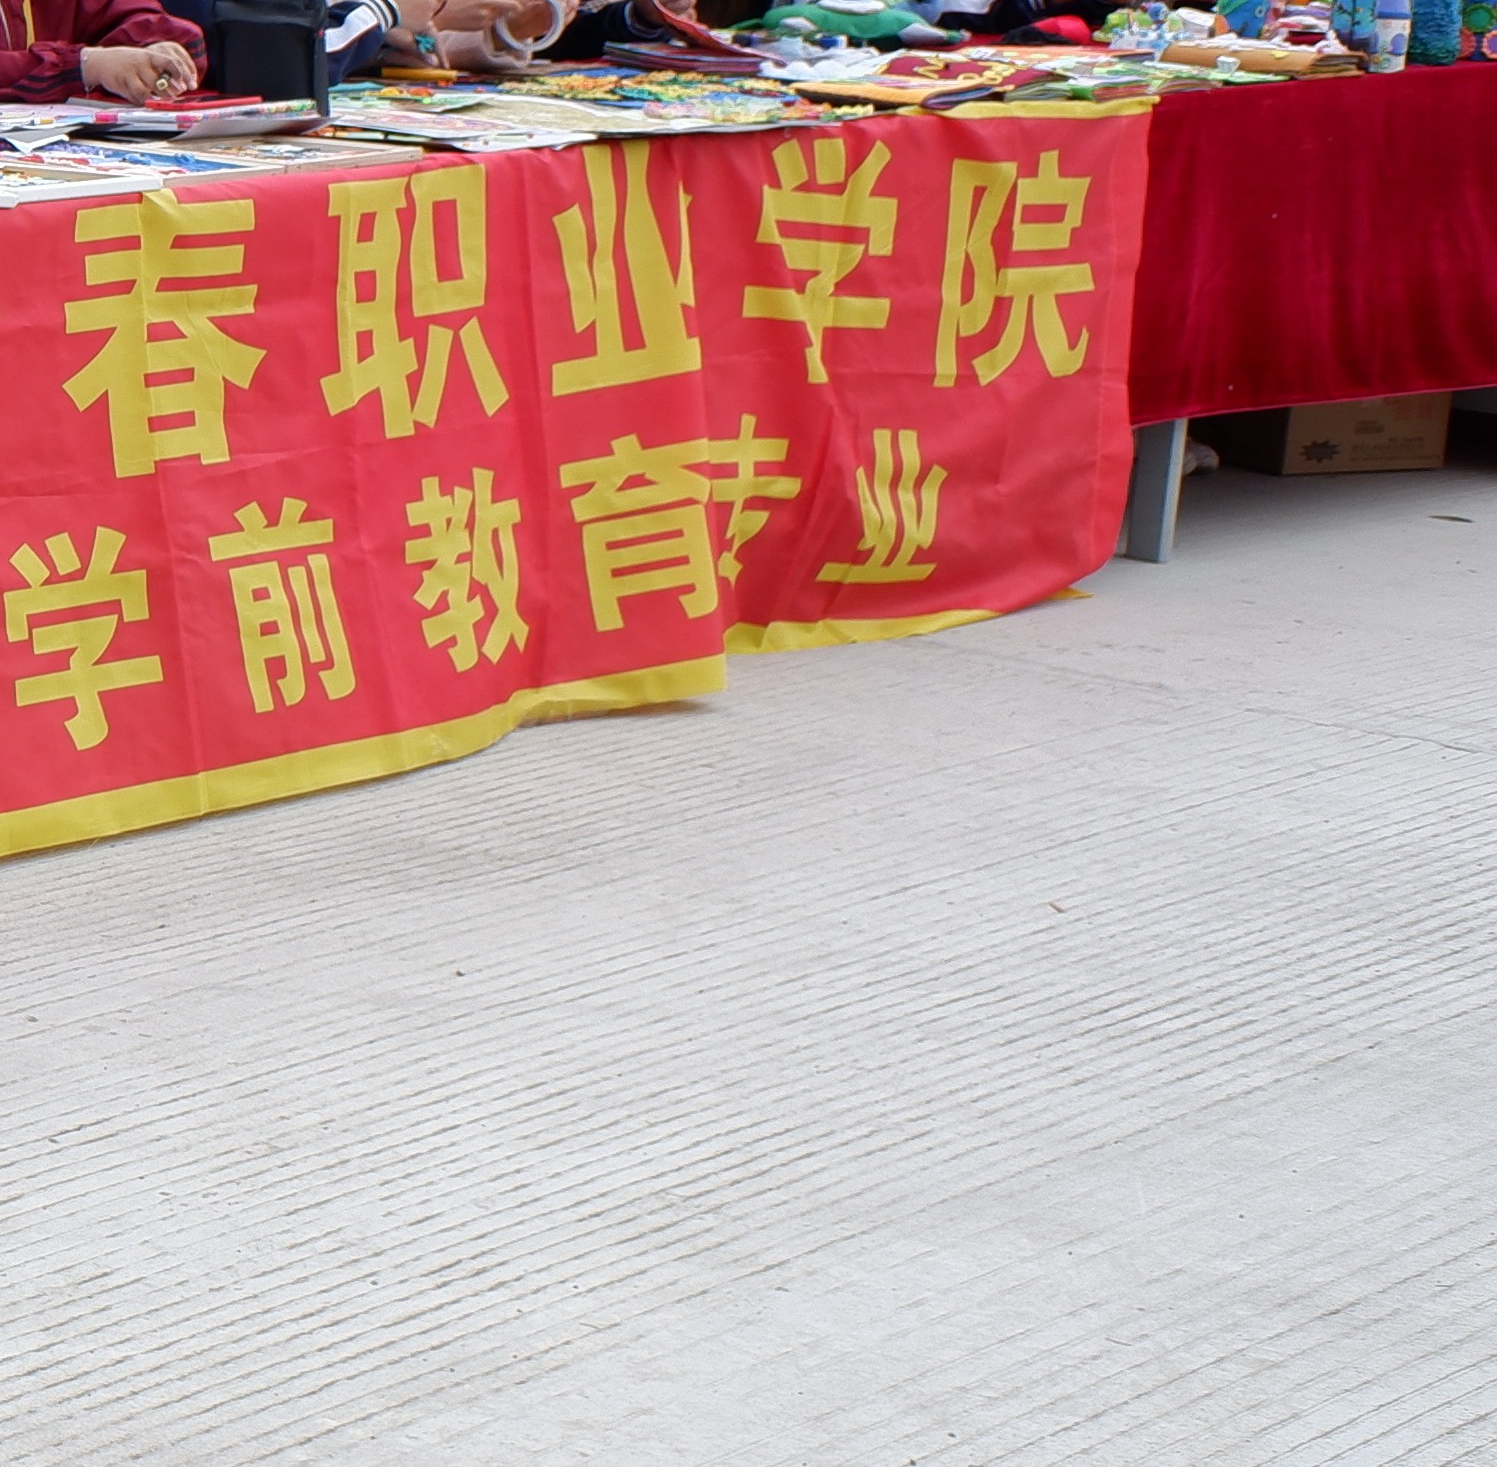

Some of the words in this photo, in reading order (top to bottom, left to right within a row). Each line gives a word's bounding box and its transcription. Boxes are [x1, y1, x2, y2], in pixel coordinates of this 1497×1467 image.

[3, 413, 949, 750] 学前教育专业
